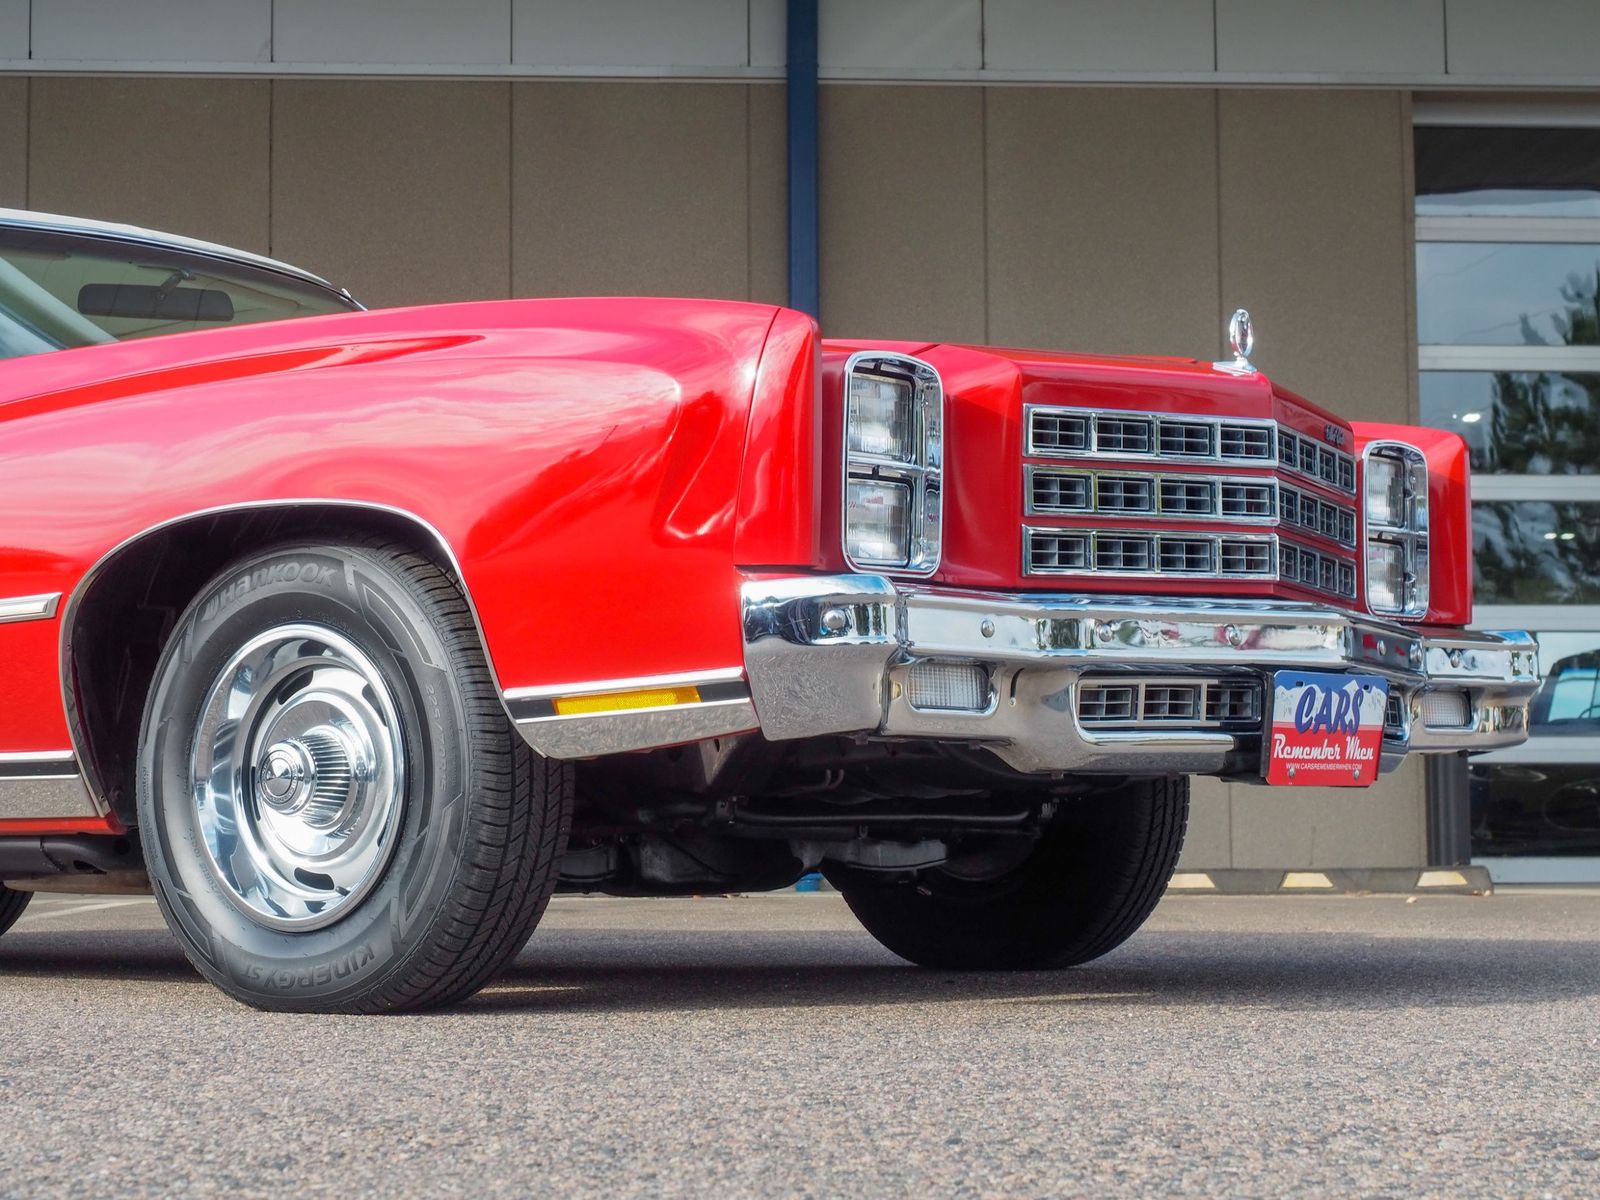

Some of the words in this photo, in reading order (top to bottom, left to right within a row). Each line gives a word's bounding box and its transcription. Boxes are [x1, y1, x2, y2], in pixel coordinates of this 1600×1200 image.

[1295, 687, 1364, 735] CARS
[1273, 733, 1341, 759] Remember
[1345, 736, 1374, 760] When
